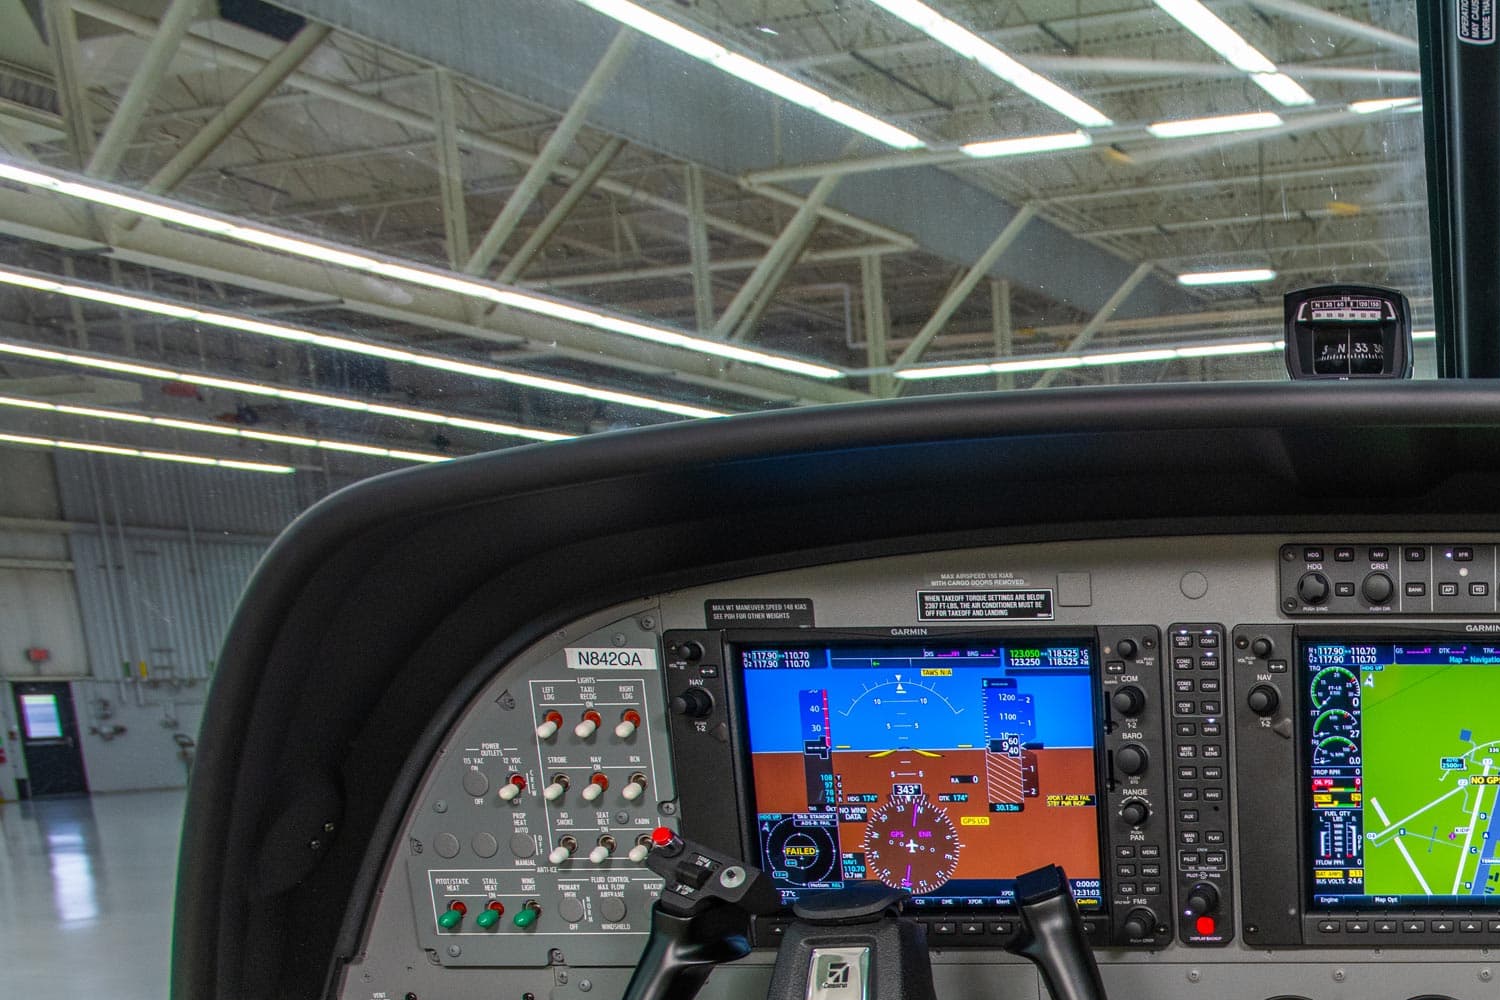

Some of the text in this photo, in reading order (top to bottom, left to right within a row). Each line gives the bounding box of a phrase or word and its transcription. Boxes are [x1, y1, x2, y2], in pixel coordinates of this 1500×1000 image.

[1482, 16, 1490, 38] MORE
[1338, 343, 1368, 353] N 33
[891, 628, 927, 636] GARMIN
[578, 652, 642, 666] N842QA
[1049, 658, 1078, 666] 118.525
[1449, 656, 1463, 664] Map
[753, 660, 810, 668] 117.90 110.70
[897, 786, 919, 794] 343°
